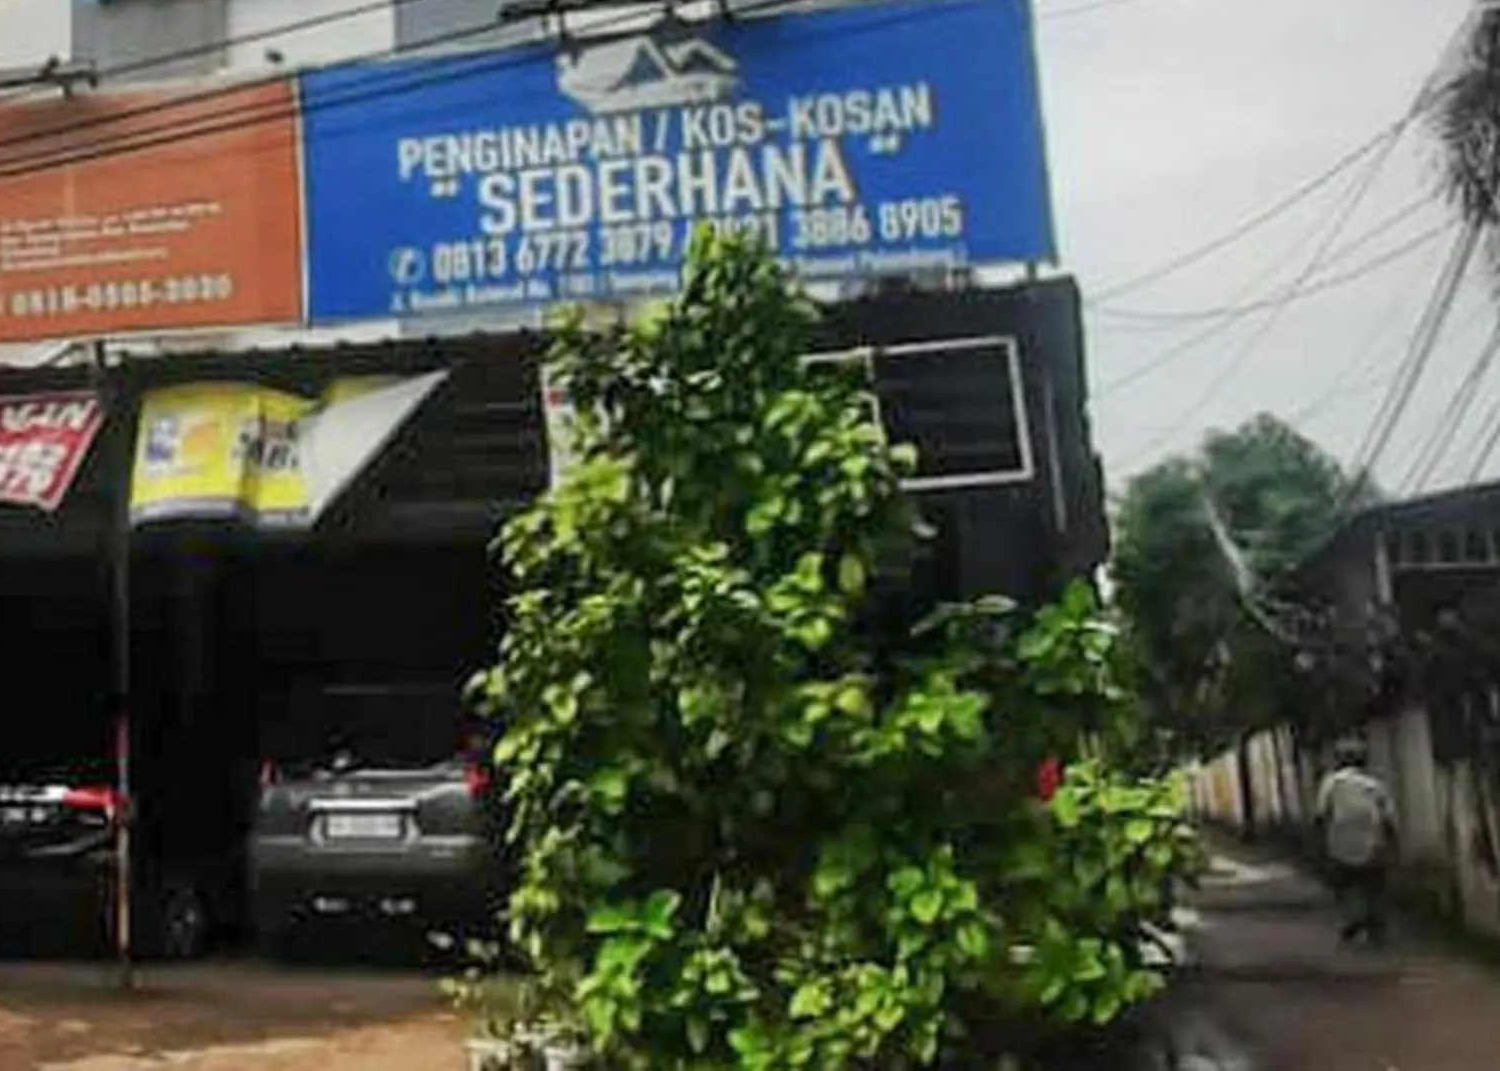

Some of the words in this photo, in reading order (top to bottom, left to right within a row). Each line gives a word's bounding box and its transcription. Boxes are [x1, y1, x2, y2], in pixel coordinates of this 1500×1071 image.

[398, 114, 641, 179] PENGINAPAN
[680, 81, 933, 149] KOS-KOSAN
[476, 137, 856, 233] SEDERHANA
[431, 240, 506, 283] 0813
[514, 227, 590, 273] 6772
[878, 195, 963, 242] 8905
